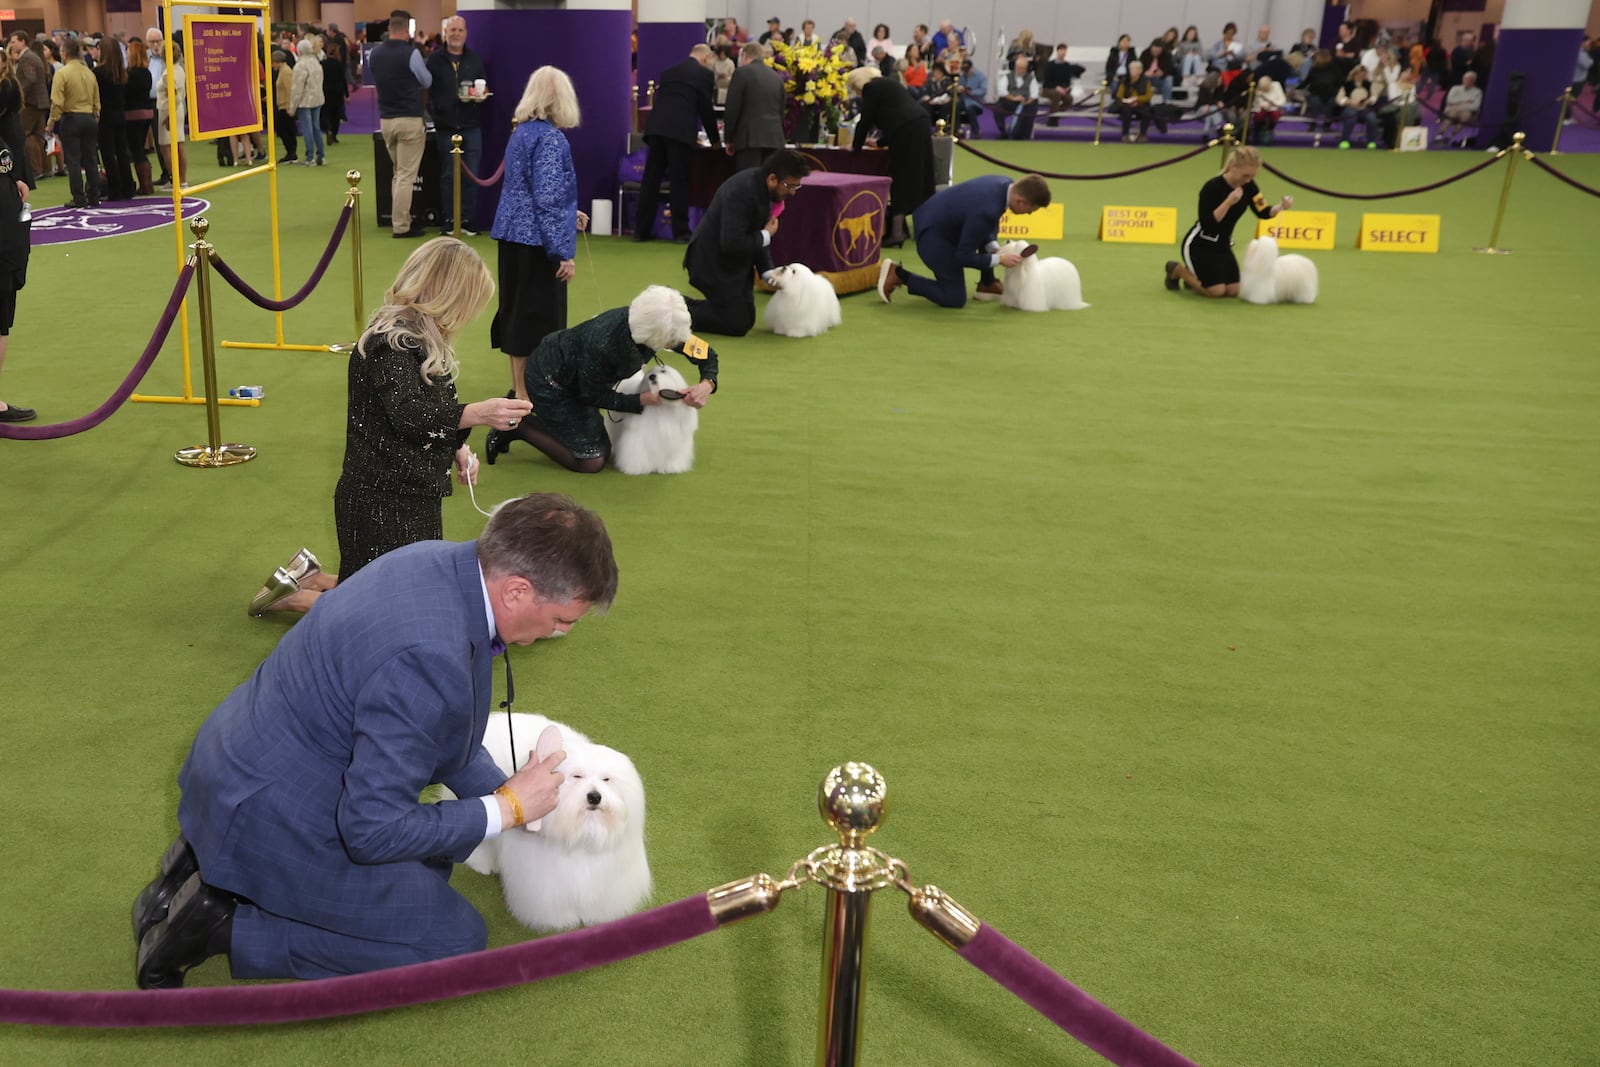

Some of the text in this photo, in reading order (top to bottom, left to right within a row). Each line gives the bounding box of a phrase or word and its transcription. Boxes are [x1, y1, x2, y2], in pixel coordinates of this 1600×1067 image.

[1108, 209, 1130, 218] BEST
[1108, 219, 1153, 228] OPPOSITE
[1267, 226, 1324, 240] SELECT
[1370, 229, 1427, 244] SELECT
